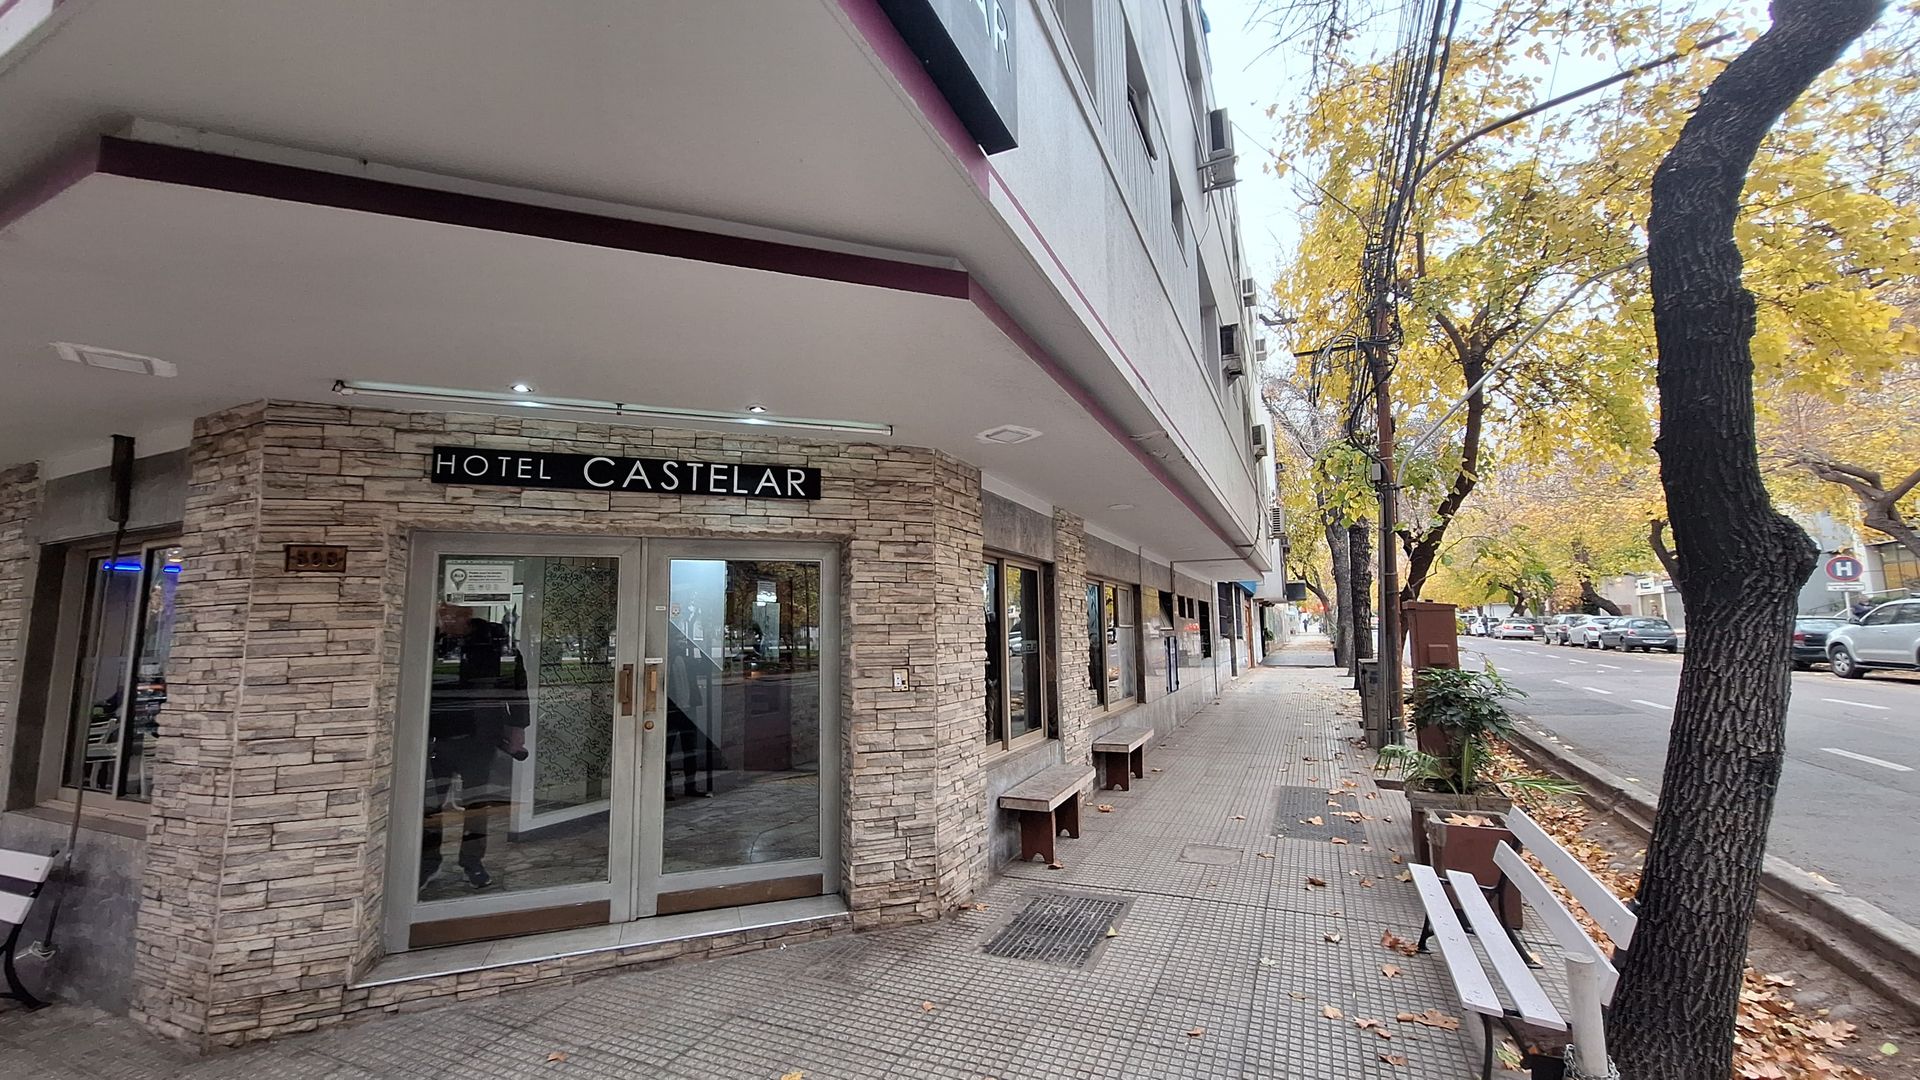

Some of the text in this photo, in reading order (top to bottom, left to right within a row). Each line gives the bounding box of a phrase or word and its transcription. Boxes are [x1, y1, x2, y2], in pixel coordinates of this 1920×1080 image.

[436, 453, 806, 496] HOTEL CASTELAR
[1835, 561, 1853, 577] H
